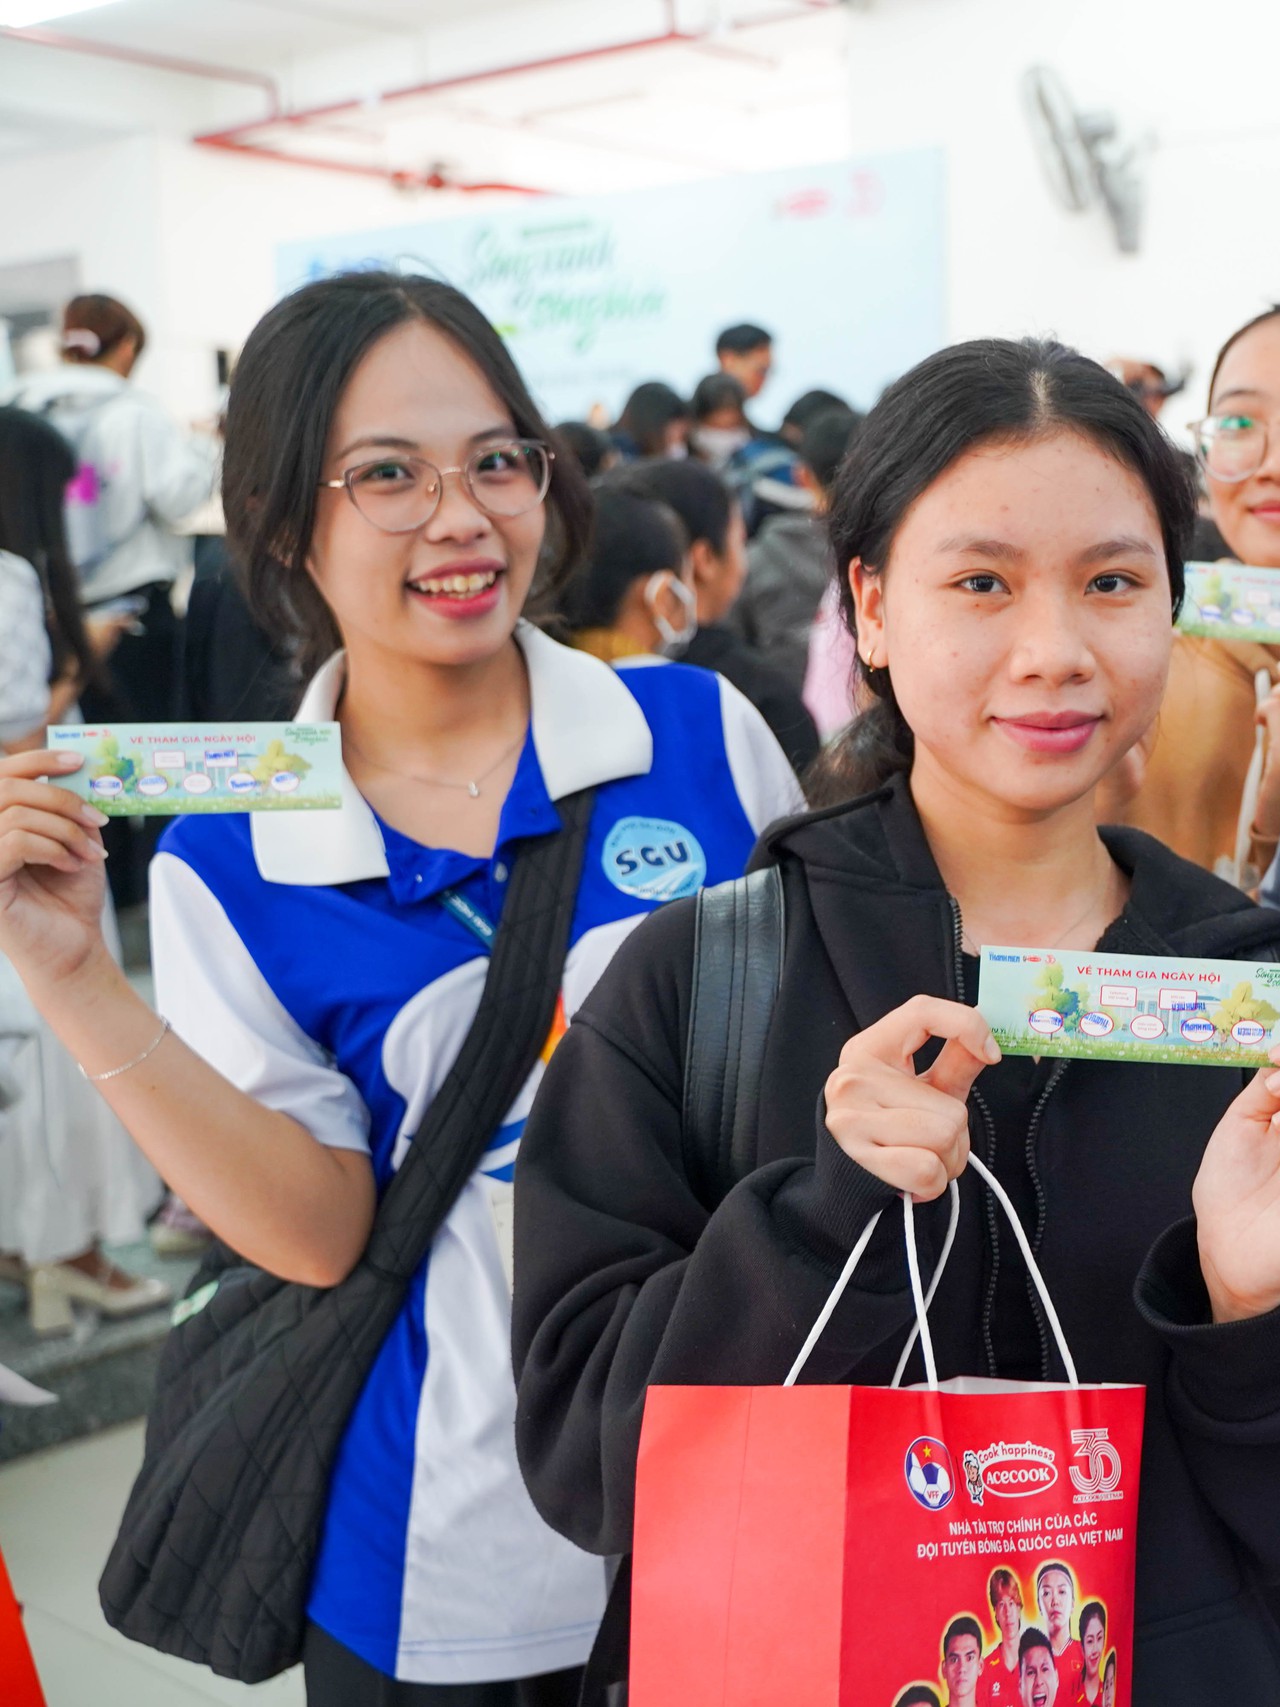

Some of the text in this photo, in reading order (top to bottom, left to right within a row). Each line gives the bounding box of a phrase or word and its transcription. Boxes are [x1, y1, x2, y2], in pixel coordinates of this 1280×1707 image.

[616, 841, 688, 876] SGU
[1097, 967, 1132, 978] THAM
[1136, 970, 1157, 979] GIA
[1161, 971, 1195, 981] NGÀY
[1198, 972, 1221, 984] HỘI
[979, 1442, 1053, 1464] Cook happiness
[927, 1489, 939, 1499] VFF
[949, 1510, 1098, 1537] NHÀ TÀI TRỢ CHÍNH CỦA CÁC
[917, 1542, 939, 1560] ĐỘI
[978, 1538, 1003, 1554] BÓNG
[1003, 1538, 1016, 1553] ĐÁ
[1017, 1534, 1053, 1552] QUỐC
[1056, 1534, 1077, 1547] GIA
[1079, 1529, 1103, 1546] VIỆT
[1104, 1527, 1124, 1542] NAM
